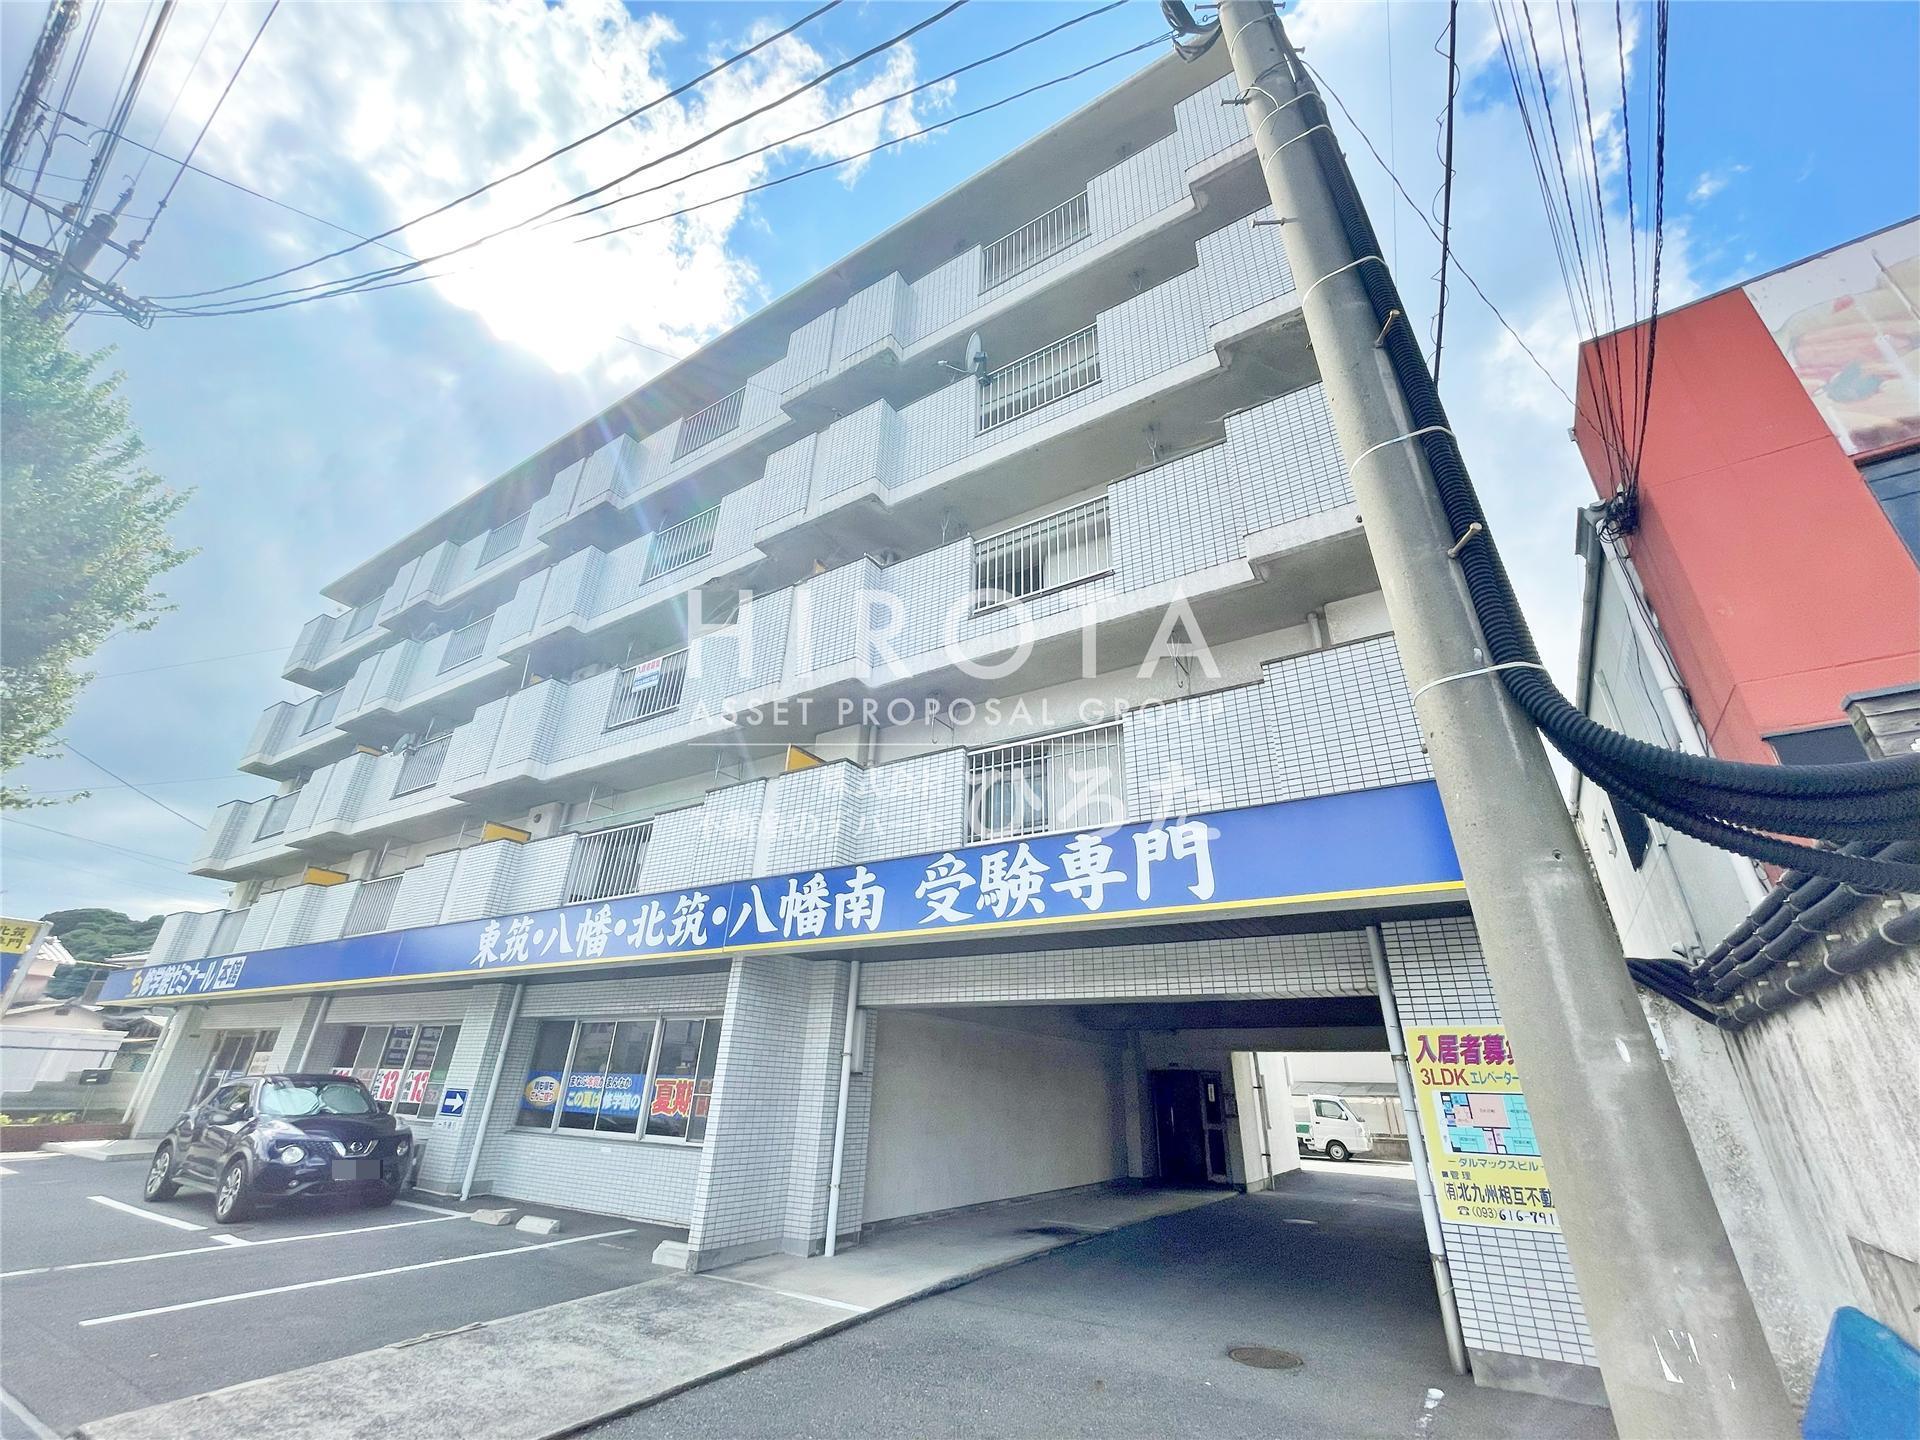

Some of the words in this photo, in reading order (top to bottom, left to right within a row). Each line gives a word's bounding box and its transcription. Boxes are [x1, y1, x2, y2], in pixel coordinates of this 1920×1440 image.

[914, 820, 1216, 925] 受験専門
[1420, 1068, 1470, 1086] 3LDK
[1470, 1070, 1519, 1085] エレベーター
[651, 1078, 694, 1117] 夏期
